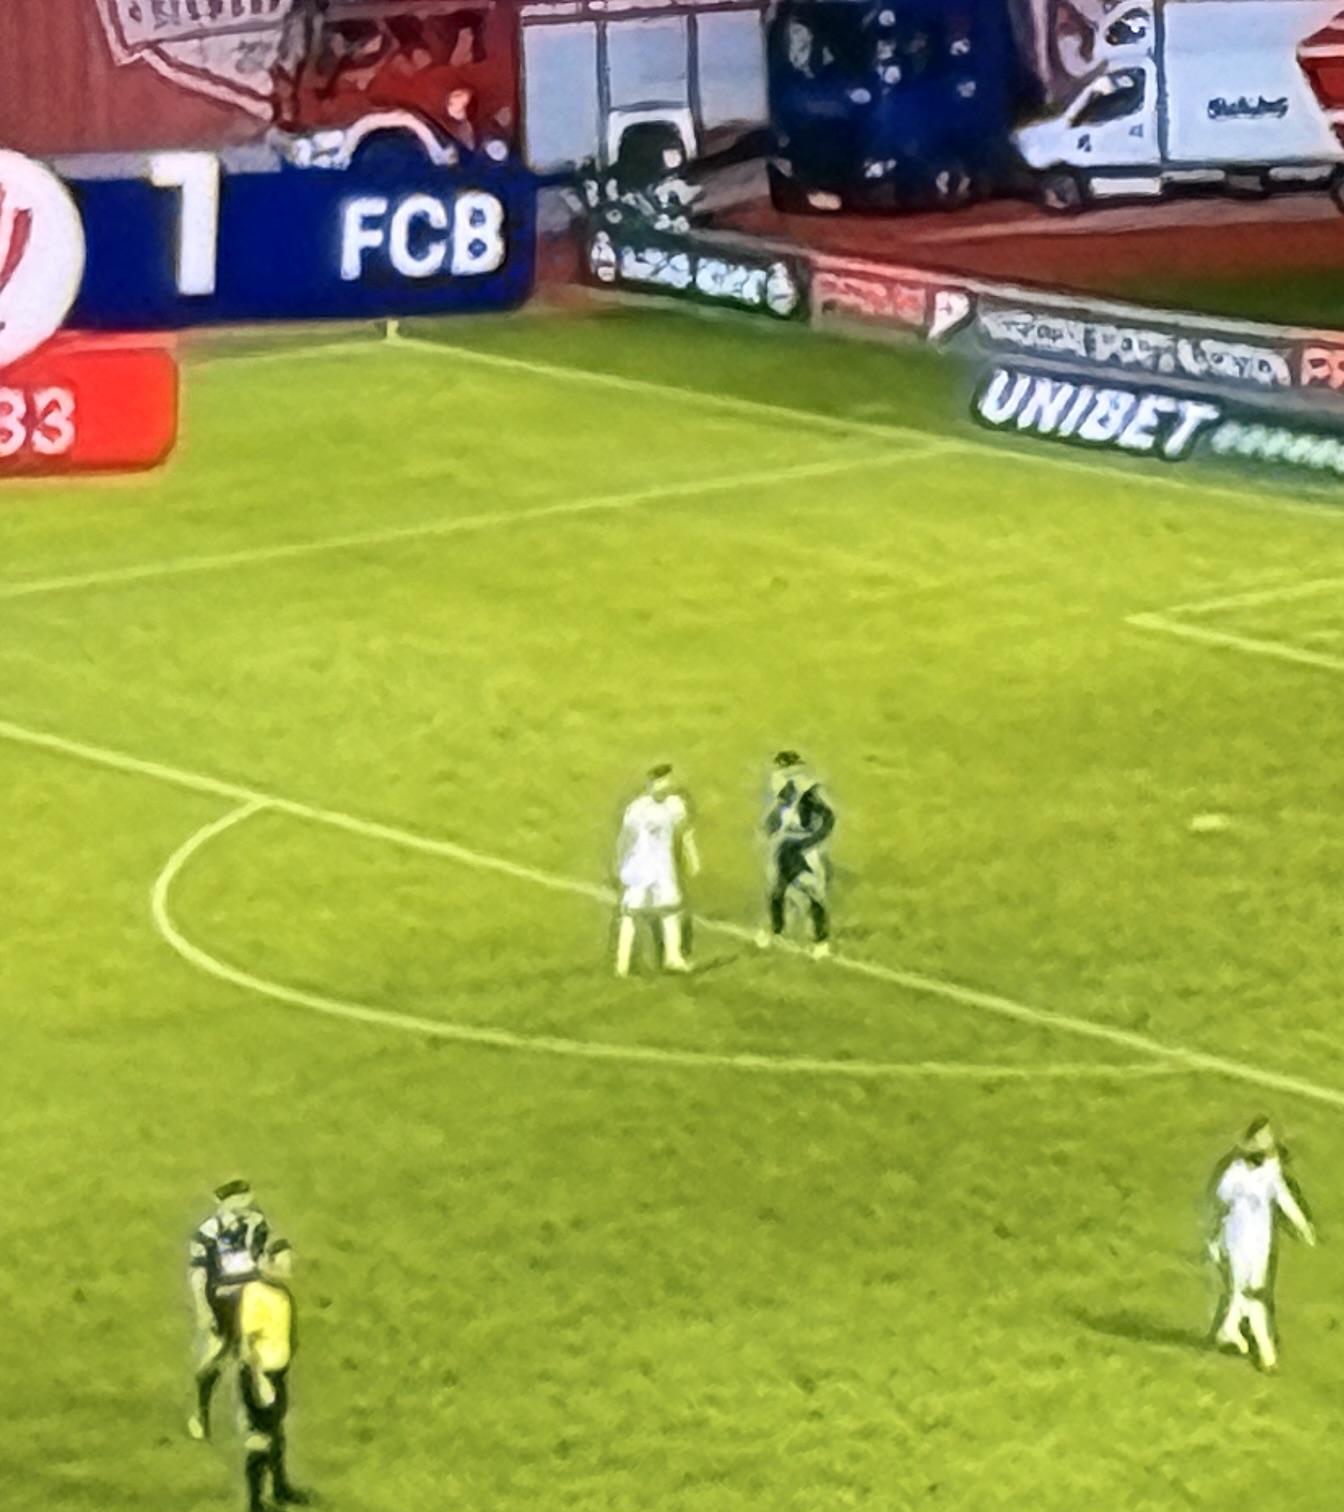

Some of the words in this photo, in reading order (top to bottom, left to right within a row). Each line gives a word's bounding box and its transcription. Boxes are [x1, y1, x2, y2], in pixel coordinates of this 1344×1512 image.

[147, 151, 220, 296] 1
[340, 190, 506, 281] FCB
[978, 369, 1220, 456] UNIBET
